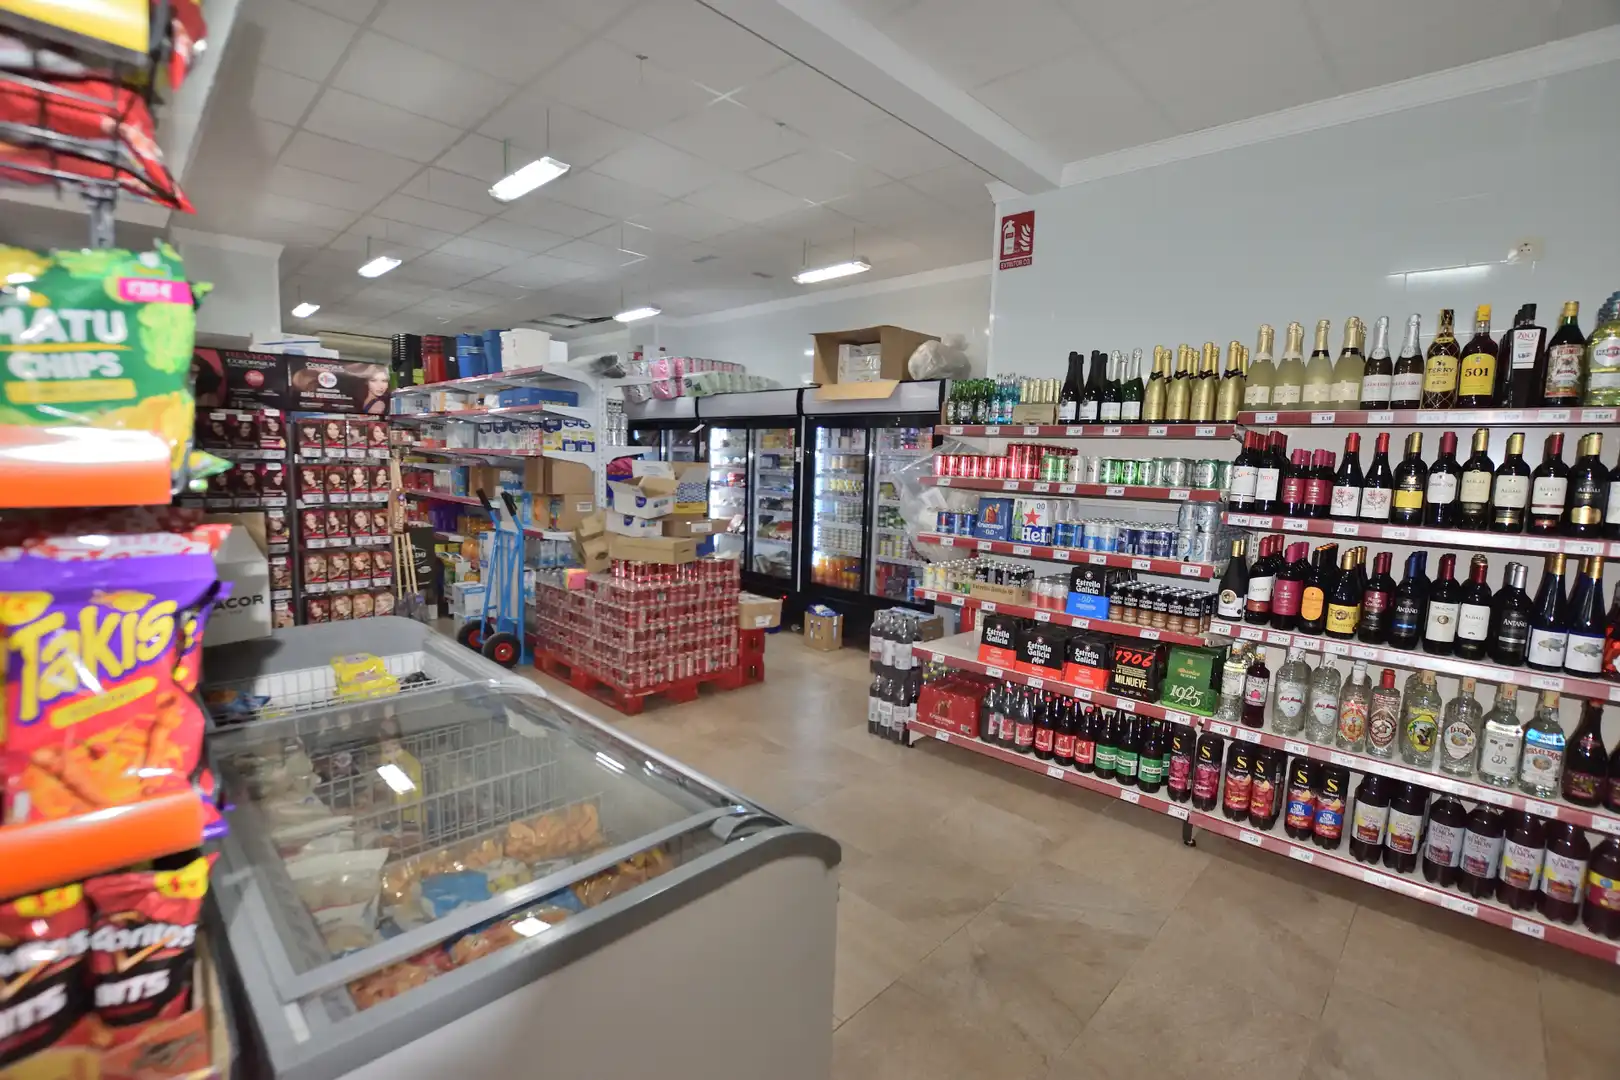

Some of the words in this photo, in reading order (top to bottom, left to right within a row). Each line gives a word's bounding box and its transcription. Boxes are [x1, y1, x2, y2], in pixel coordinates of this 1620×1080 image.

[7, 352, 124, 380] CHIPS
[1464, 368, 1488, 377] 501
[1076, 578, 1100, 589] Estrella
[1076, 586, 1099, 594] Galicia
[1503, 618, 1528, 628] ANTAÑO
[986, 627, 1010, 638] Estrella
[986, 635, 1008, 645] Galicia
[1027, 641, 1052, 653] Estrella
[1028, 649, 1050, 659] Galicia
[1074, 648, 1099, 659] Estrella
[1116, 650, 1154, 667] 1906
[9, 601, 178, 721] Takis
[1074, 654, 1096, 666] Galicia
[1114, 674, 1147, 690] MILNUEVE
[1170, 684, 1204, 708] 1925
